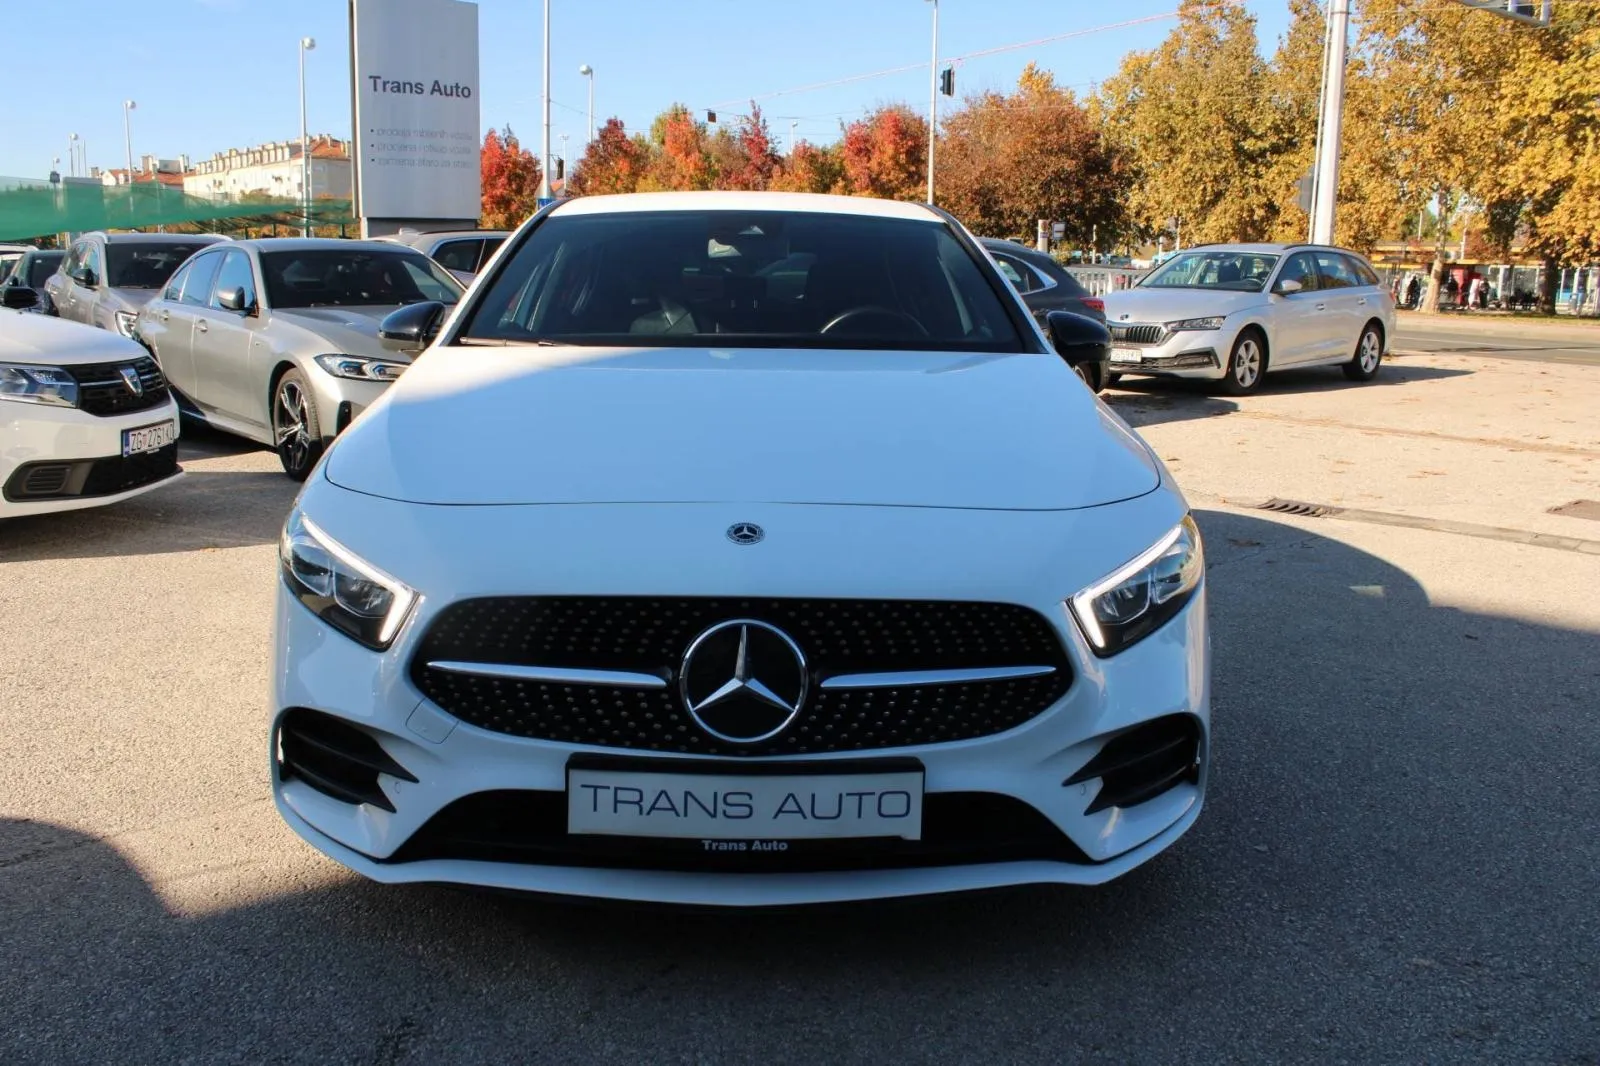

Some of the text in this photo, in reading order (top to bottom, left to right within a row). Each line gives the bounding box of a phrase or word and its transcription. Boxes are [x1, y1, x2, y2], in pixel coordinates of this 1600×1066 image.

[368, 75, 471, 98] Trans Auto
[131, 431, 142, 451] ZG
[580, 784, 912, 820] TRANS AUTO
[701, 839, 788, 851] Trans Auto
